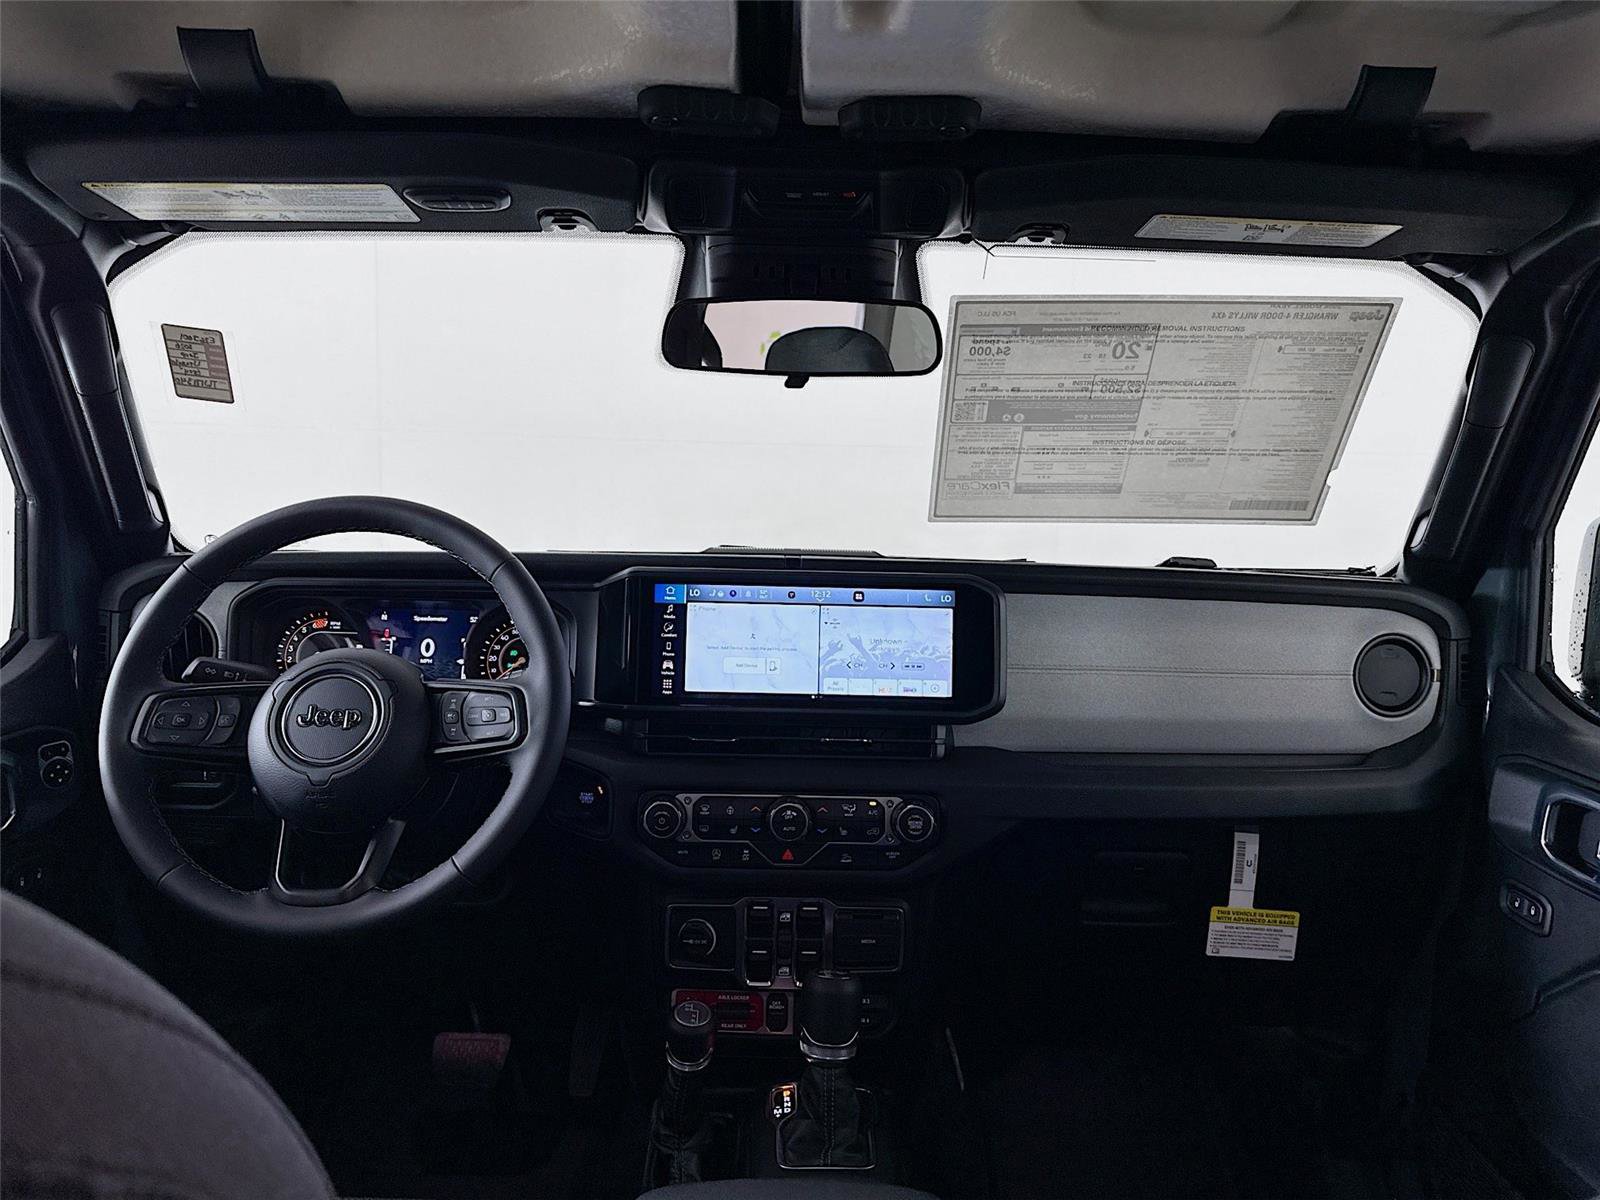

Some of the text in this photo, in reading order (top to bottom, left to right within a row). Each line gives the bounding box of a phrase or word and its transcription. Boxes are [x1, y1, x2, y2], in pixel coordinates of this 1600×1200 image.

[689, 589, 701, 597] LO
[810, 590, 831, 598] 12:12
[413, 615, 448, 623] Speedometer
[420, 638, 436, 658] 0
[297, 704, 362, 731] Jeep
